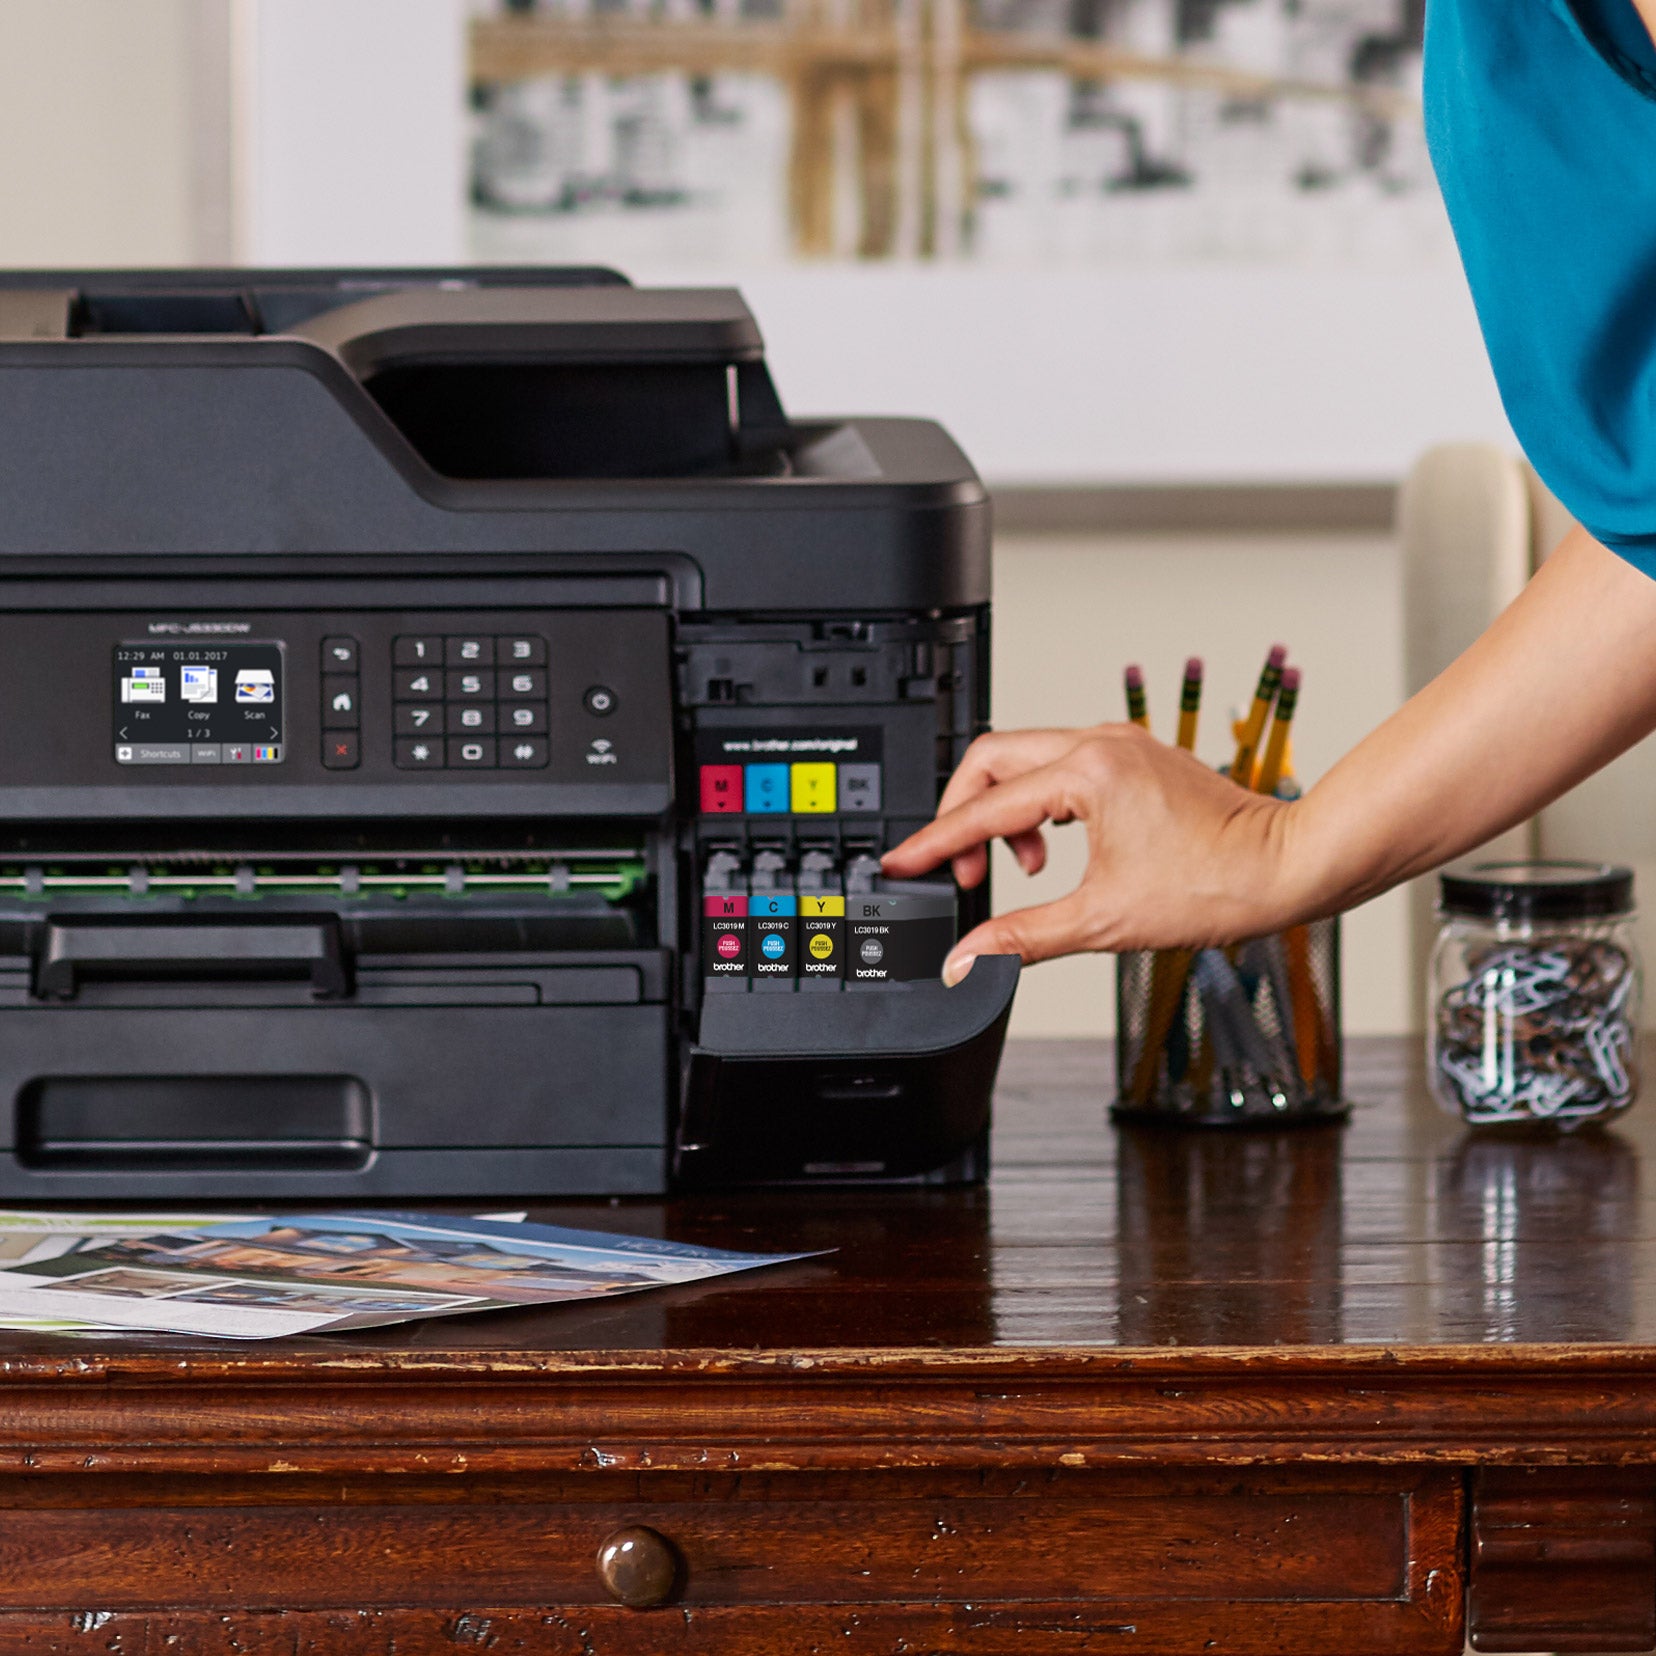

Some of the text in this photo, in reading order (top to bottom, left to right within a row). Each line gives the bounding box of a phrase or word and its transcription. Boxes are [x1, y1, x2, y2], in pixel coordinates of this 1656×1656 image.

[415, 641, 425, 658] 1
[461, 641, 481, 659] 2
[513, 641, 532, 658] 3
[118, 652, 228, 661] 12:29 AM 01.01.2017
[410, 676, 430, 692] 4
[461, 675, 481, 693] 5
[512, 675, 533, 692] 6
[135, 711, 151, 720] Fax
[188, 711, 210, 722] Copy
[244, 711, 266, 720] Scan
[410, 710, 430, 727] 7
[461, 709, 482, 727] 8
[513, 709, 534, 726] 9
[140, 750, 182, 760] Shortcuts
[461, 744, 483, 760] 0
[715, 780, 727, 792] M
[723, 902, 735, 914] M
[769, 901, 779, 913] C
[817, 901, 826, 913] Y
[863, 904, 881, 917] BK
[713, 962, 745, 971] brother
[757, 963, 789, 972] brother
[805, 963, 837, 972] brother
[856, 968, 888, 978] brother
